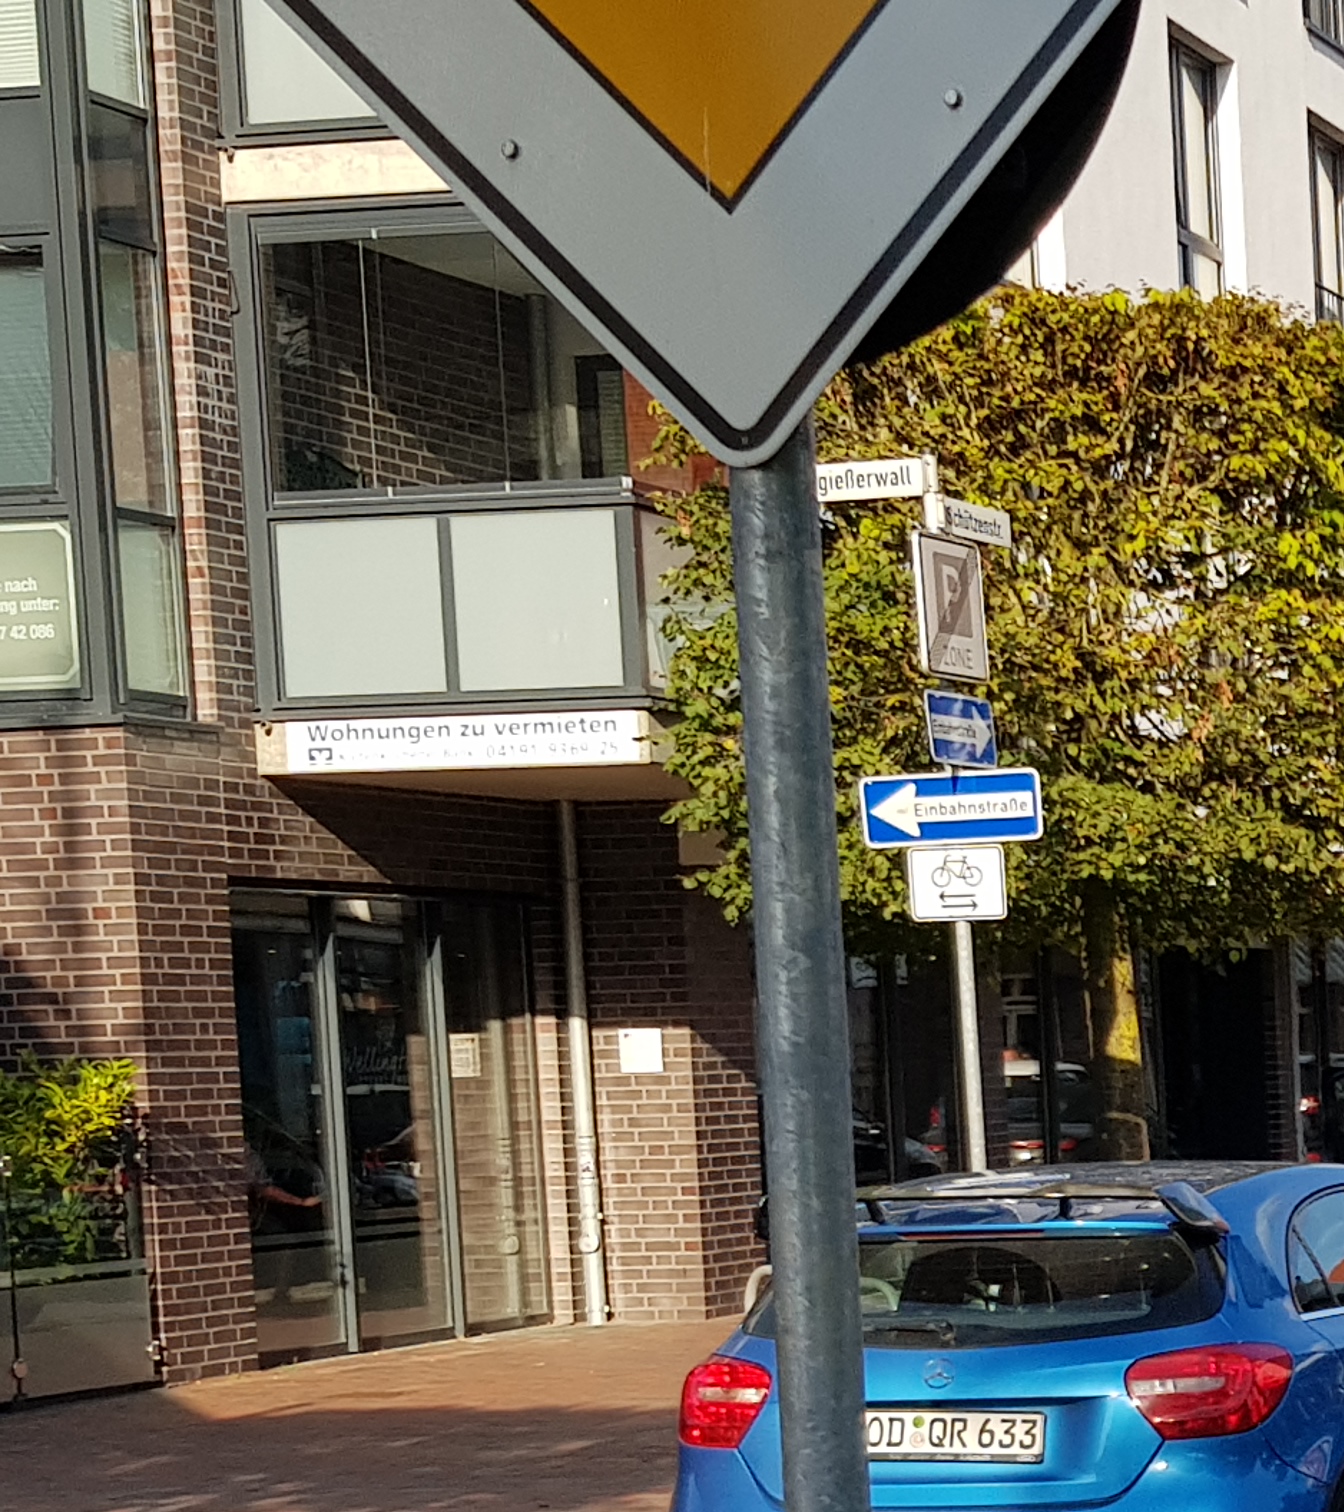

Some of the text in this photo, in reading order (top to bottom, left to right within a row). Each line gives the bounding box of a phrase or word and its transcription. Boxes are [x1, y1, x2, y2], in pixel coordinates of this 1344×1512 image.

[4, 577, 37, 592] nach
[943, 645, 974, 670] ZONE
[307, 716, 618, 745] Wohnungen zu vermieten
[913, 797, 1029, 818] Einbahnstraße
[928, 1417, 968, 1448] QR
[977, 1418, 1038, 1450] 633
